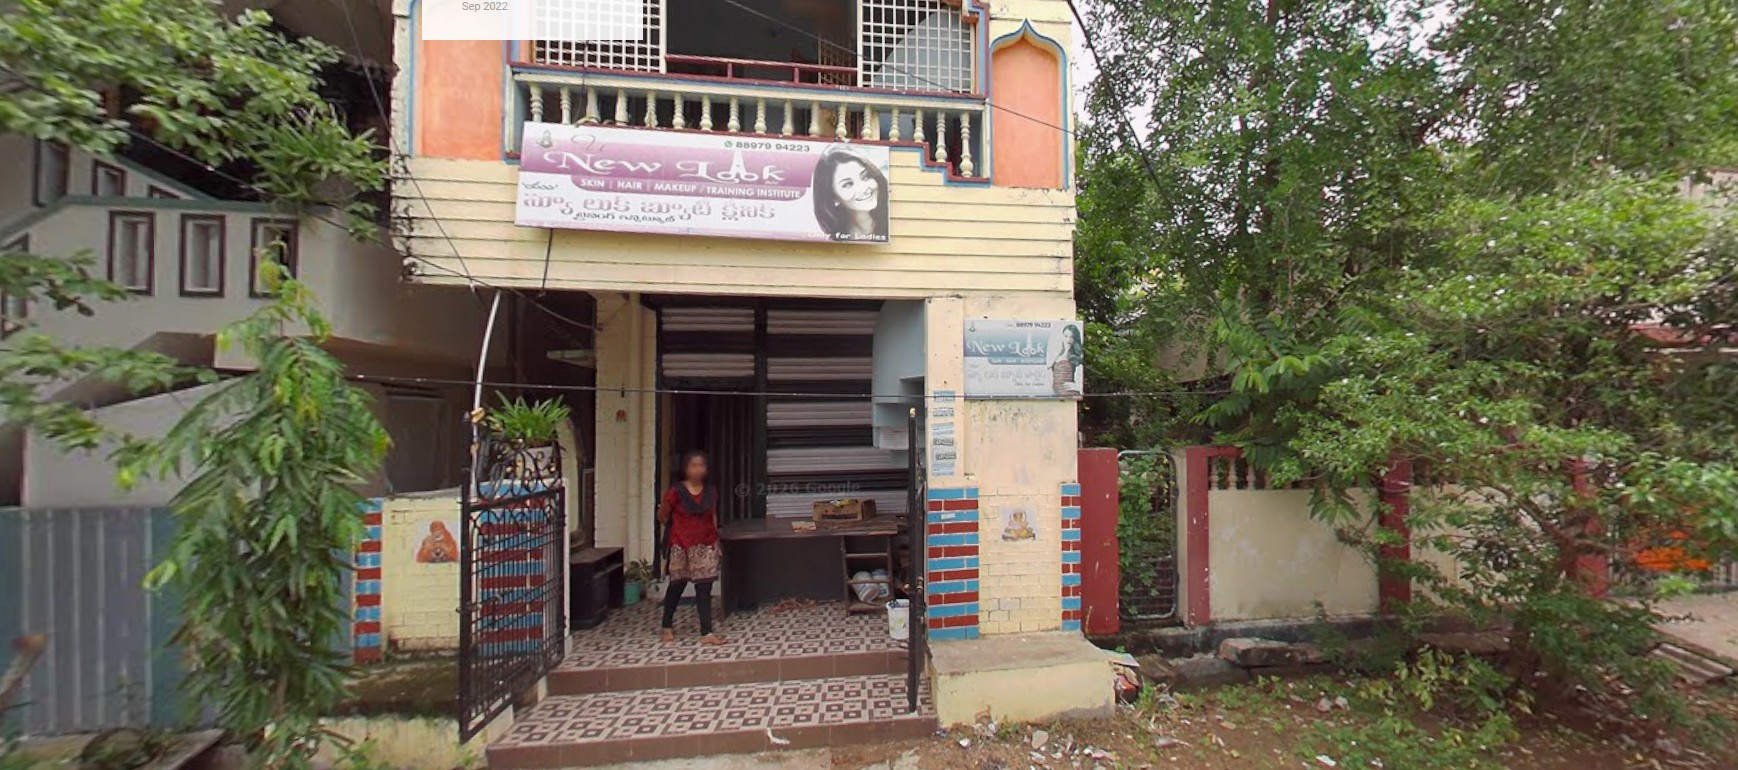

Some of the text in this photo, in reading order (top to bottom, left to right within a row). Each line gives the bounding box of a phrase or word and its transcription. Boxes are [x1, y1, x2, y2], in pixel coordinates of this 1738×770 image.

[735, 141, 810, 152] 88979 94223
[543, 149, 786, 184] New Look
[581, 179, 800, 198] SKIN HAIR MAKEUP TRAINING INSTITUTE
[854, 233, 886, 241] Ladies
[966, 333, 1045, 357] New Look
